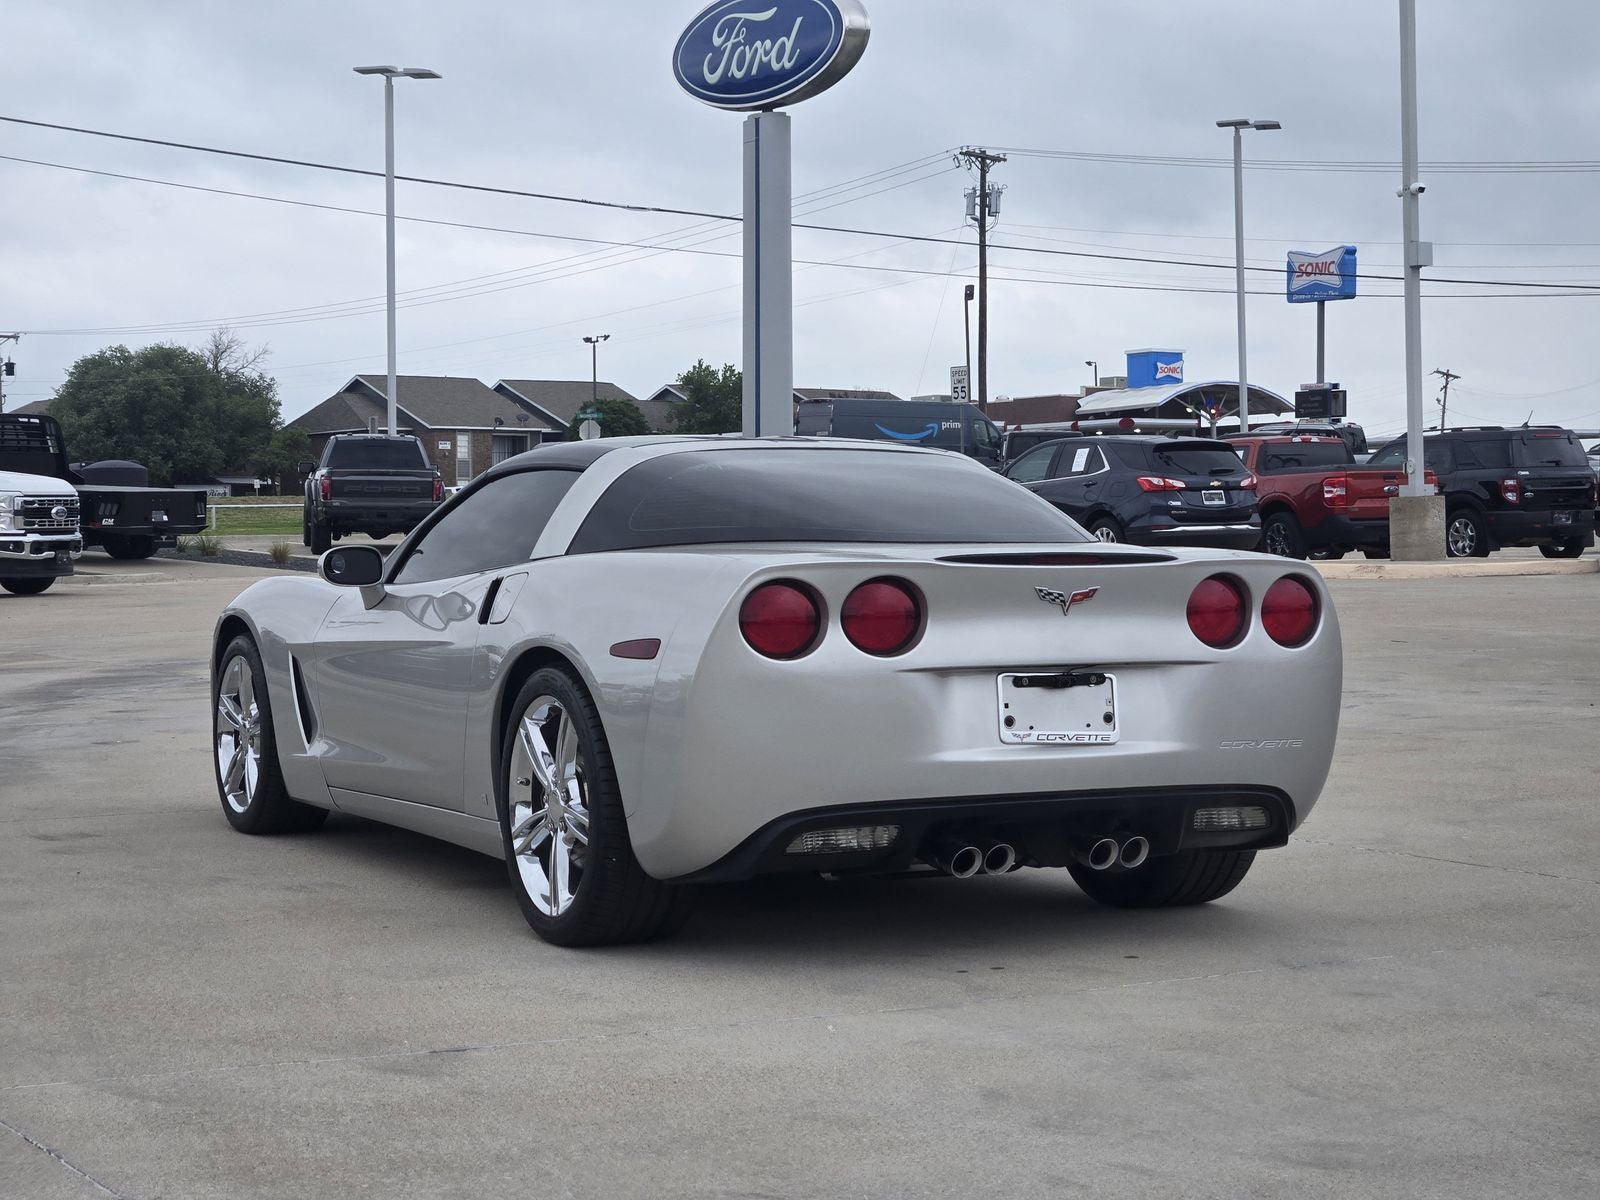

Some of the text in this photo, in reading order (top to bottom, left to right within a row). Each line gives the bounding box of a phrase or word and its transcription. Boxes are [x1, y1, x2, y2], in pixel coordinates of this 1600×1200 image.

[703, 6, 803, 85] Ford
[1296, 260, 1335, 278] SONIC
[1159, 366, 1180, 374] SONIC
[953, 386, 967, 400] 55
[941, 419, 962, 431] prim
[344, 485, 421, 493] FORD
[1036, 733, 1111, 742] CORVETTE
[1219, 739, 1303, 749] CORVETTE
